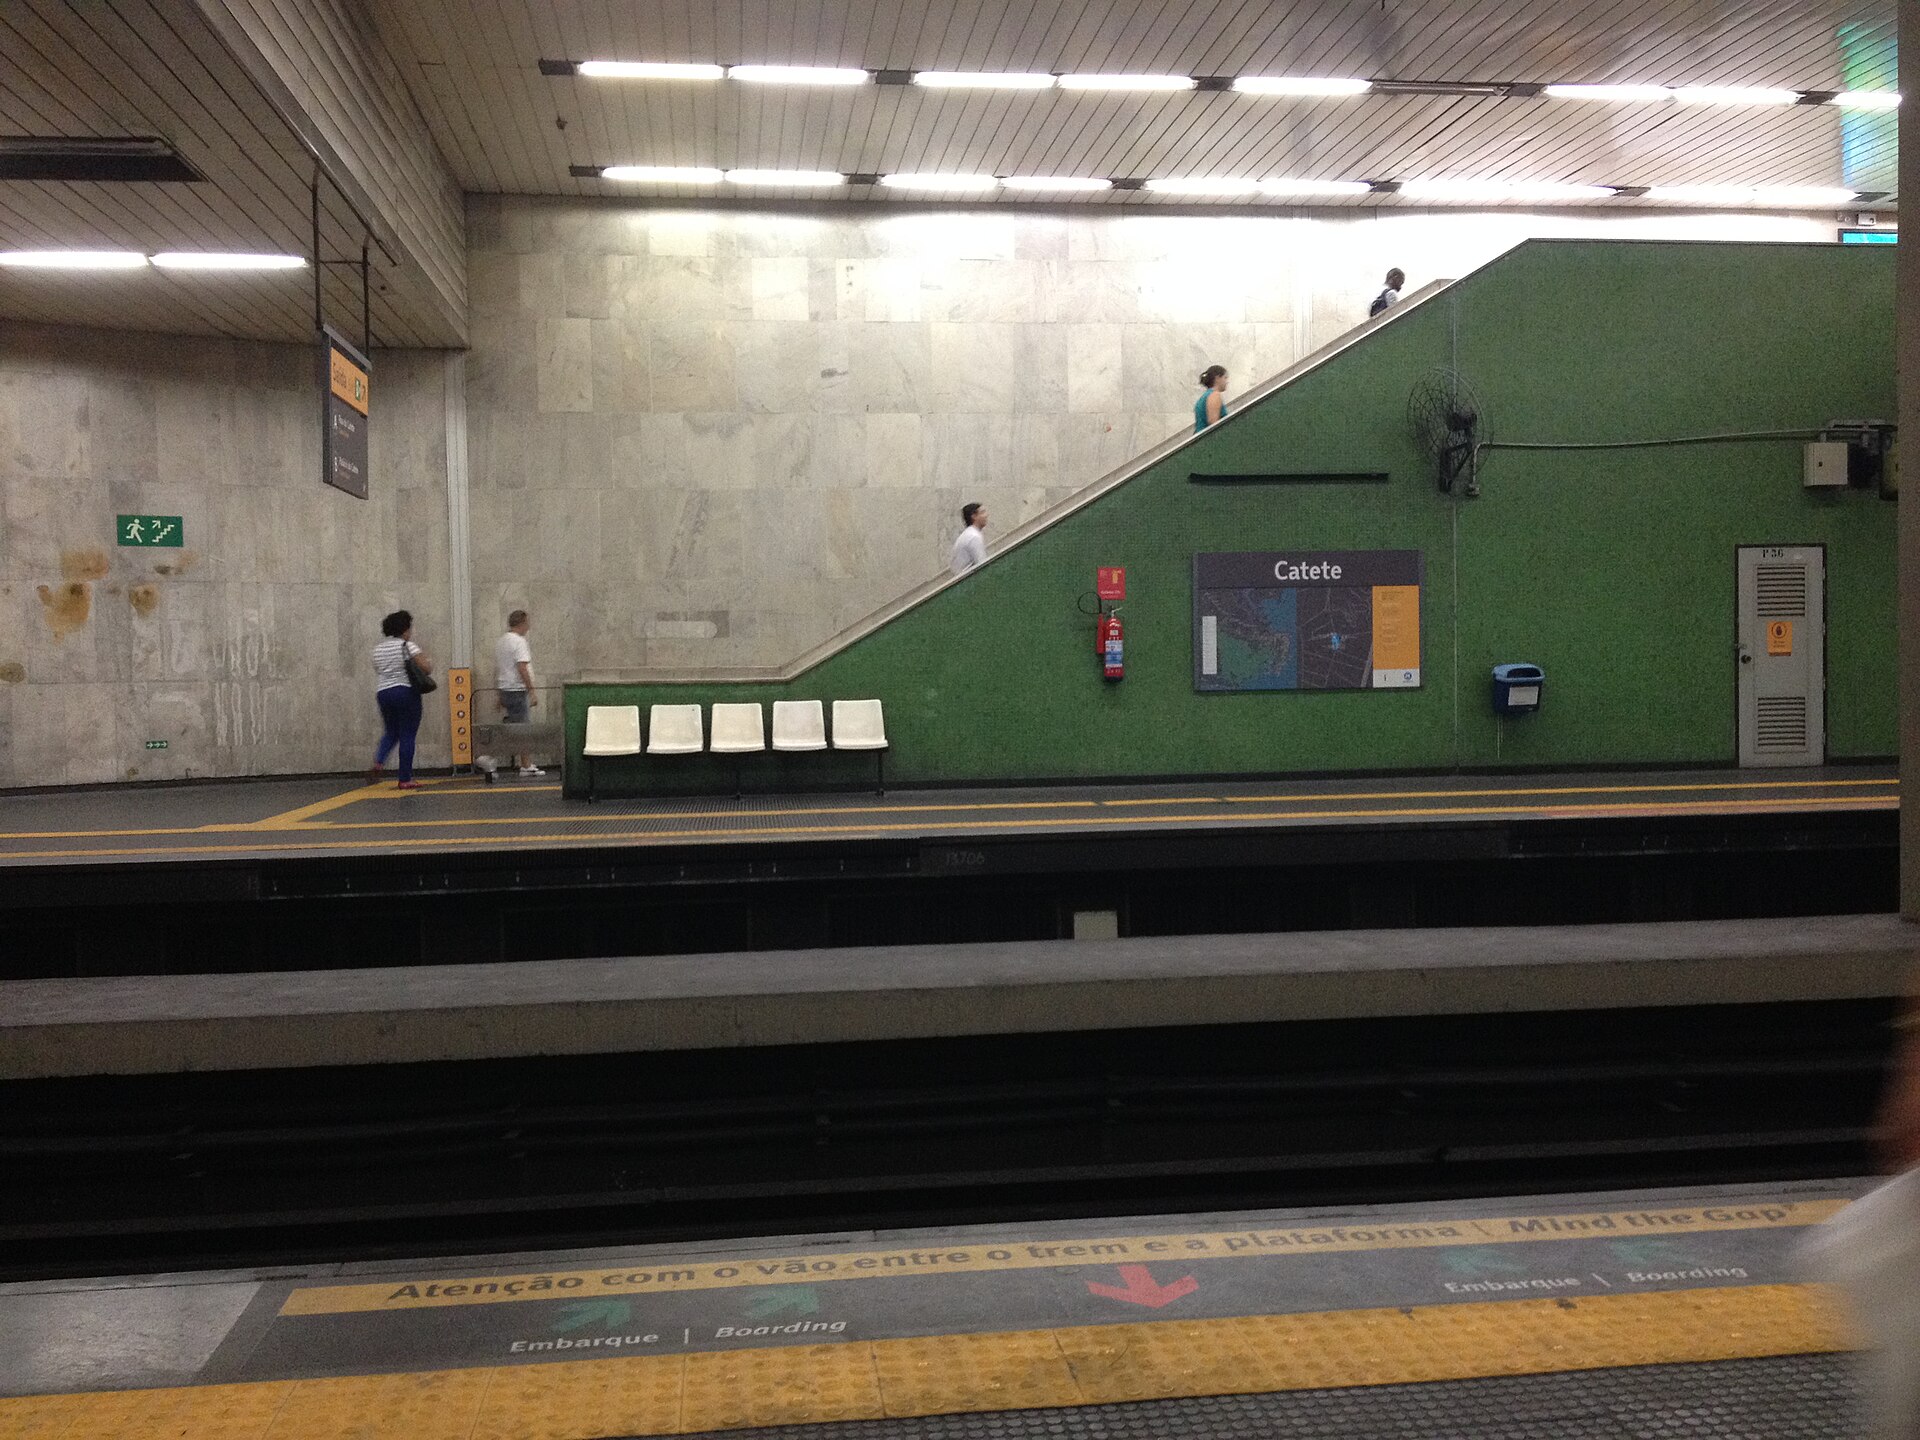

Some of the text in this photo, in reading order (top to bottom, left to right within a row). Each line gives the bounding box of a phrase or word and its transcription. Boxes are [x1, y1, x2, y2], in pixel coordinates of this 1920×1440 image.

[1274, 561, 1342, 580] Catete
[387, 1275, 584, 1301] Atenção
[601, 1268, 695, 1286] com
[713, 1267, 740, 1278] o
[756, 1259, 837, 1276] vão
[853, 1250, 970, 1269] entre
[986, 1249, 1013, 1261] o
[1026, 1239, 1128, 1258] trem
[1143, 1239, 1169, 1252] e
[1185, 1238, 1207, 1250] a
[1223, 1225, 1461, 1251] plataforma
[1508, 1214, 1617, 1233] Mind
[1624, 1211, 1695, 1226] the
[1444, 1274, 1582, 1294] Embarque
[1626, 1266, 1750, 1284] Boarding
[510, 1332, 660, 1354] Embarque
[714, 1320, 848, 1339] Boarding
